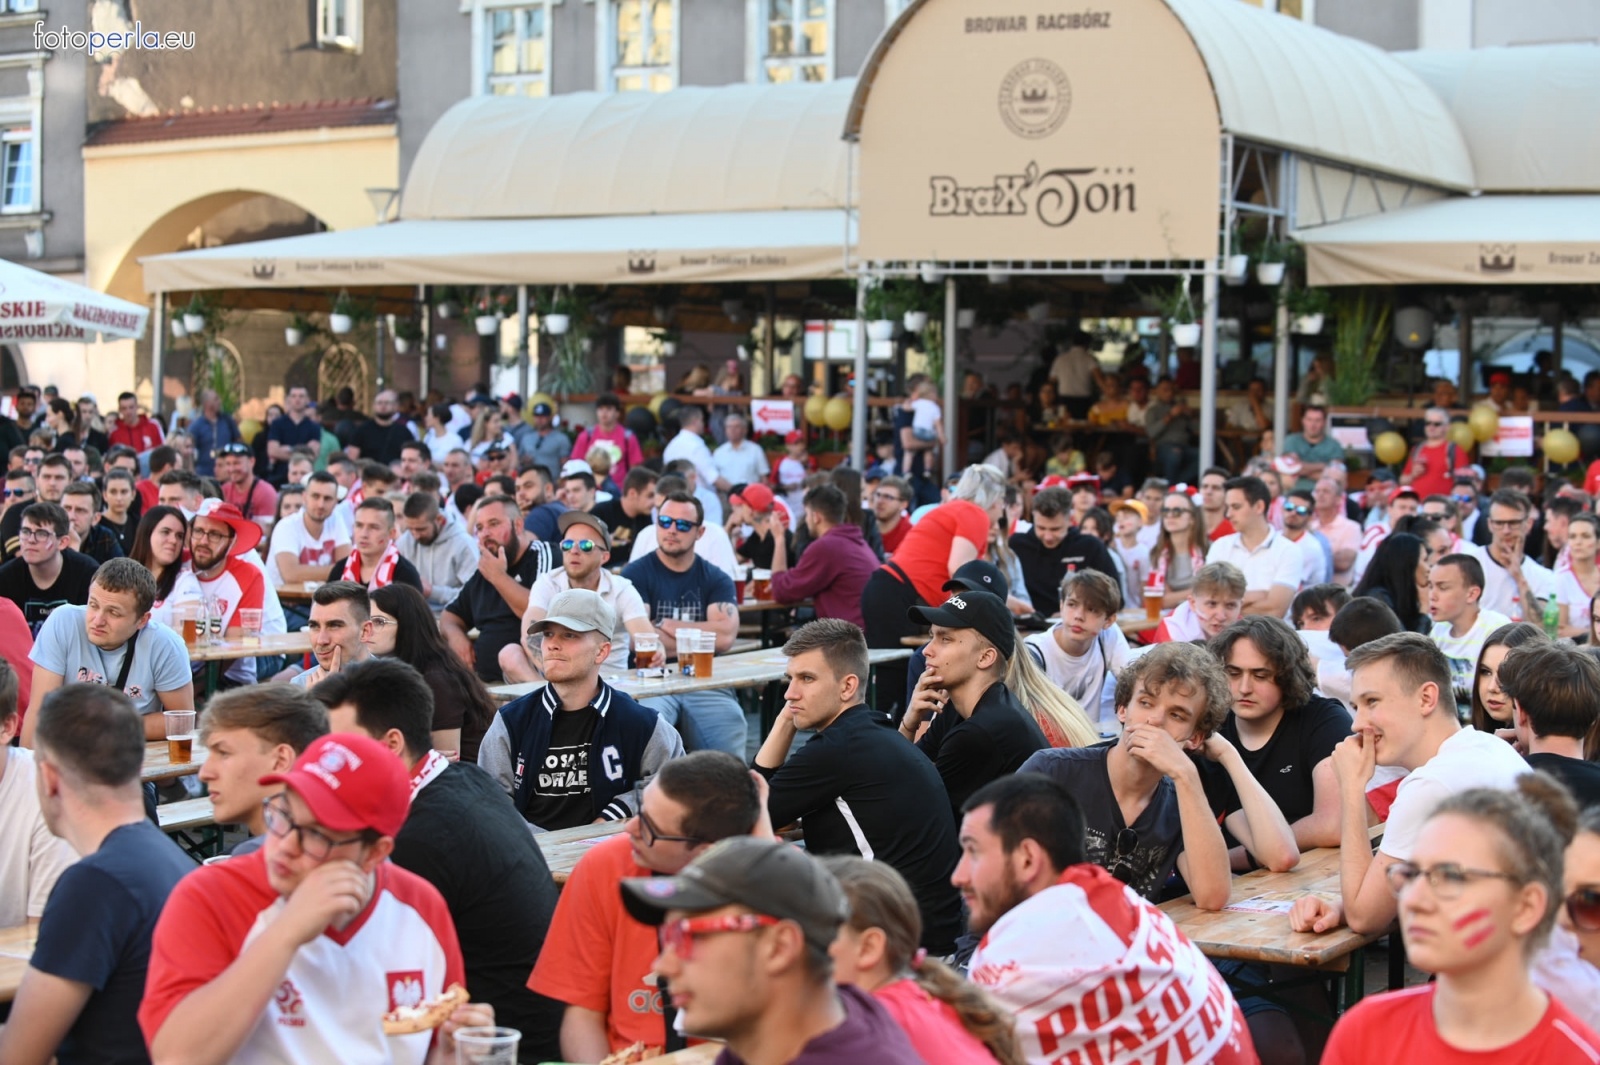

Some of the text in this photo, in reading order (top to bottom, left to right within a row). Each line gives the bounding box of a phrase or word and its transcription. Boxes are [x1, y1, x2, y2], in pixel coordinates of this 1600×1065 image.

[965, 9, 1111, 33] BROWAR RACIBÓRZ
[602, 744, 623, 782] C
